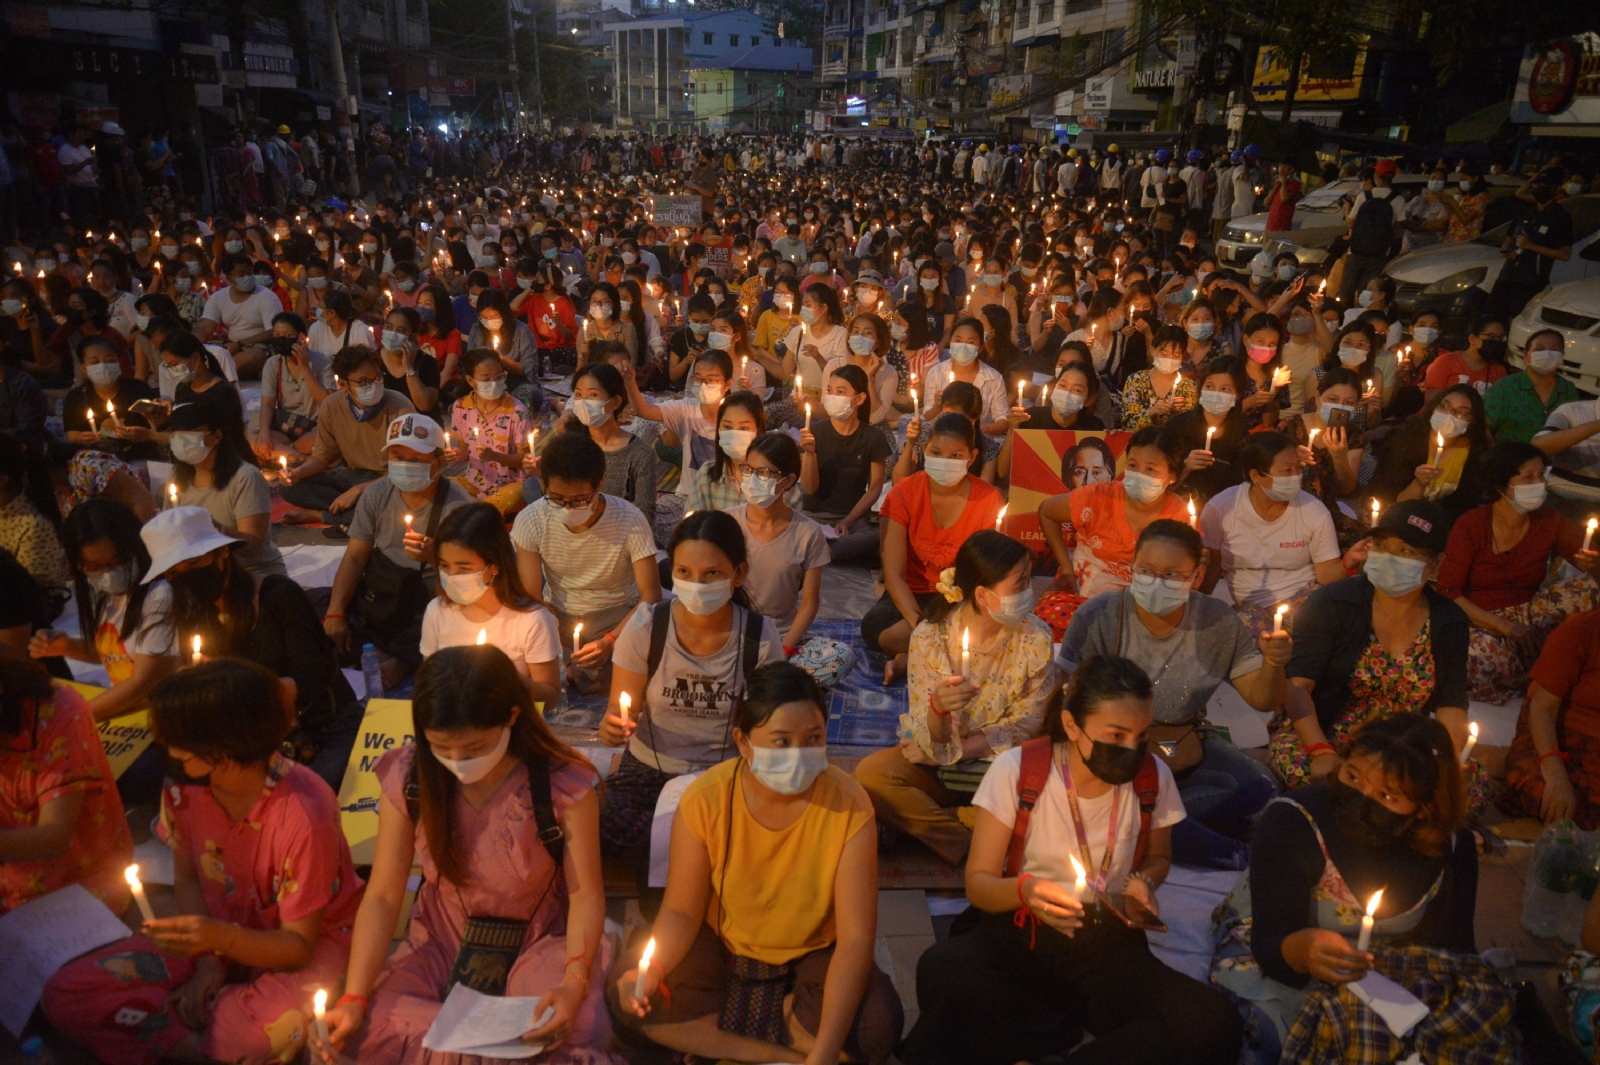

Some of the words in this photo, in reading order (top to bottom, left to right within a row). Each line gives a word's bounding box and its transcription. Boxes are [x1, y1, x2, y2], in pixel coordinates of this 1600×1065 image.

[1134, 70, 1166, 88] NATURE
[662, 686, 735, 702] BROOKLYN
[98, 719, 151, 742] Accept
[101, 740, 134, 757] OUP
[364, 732, 396, 751] We
